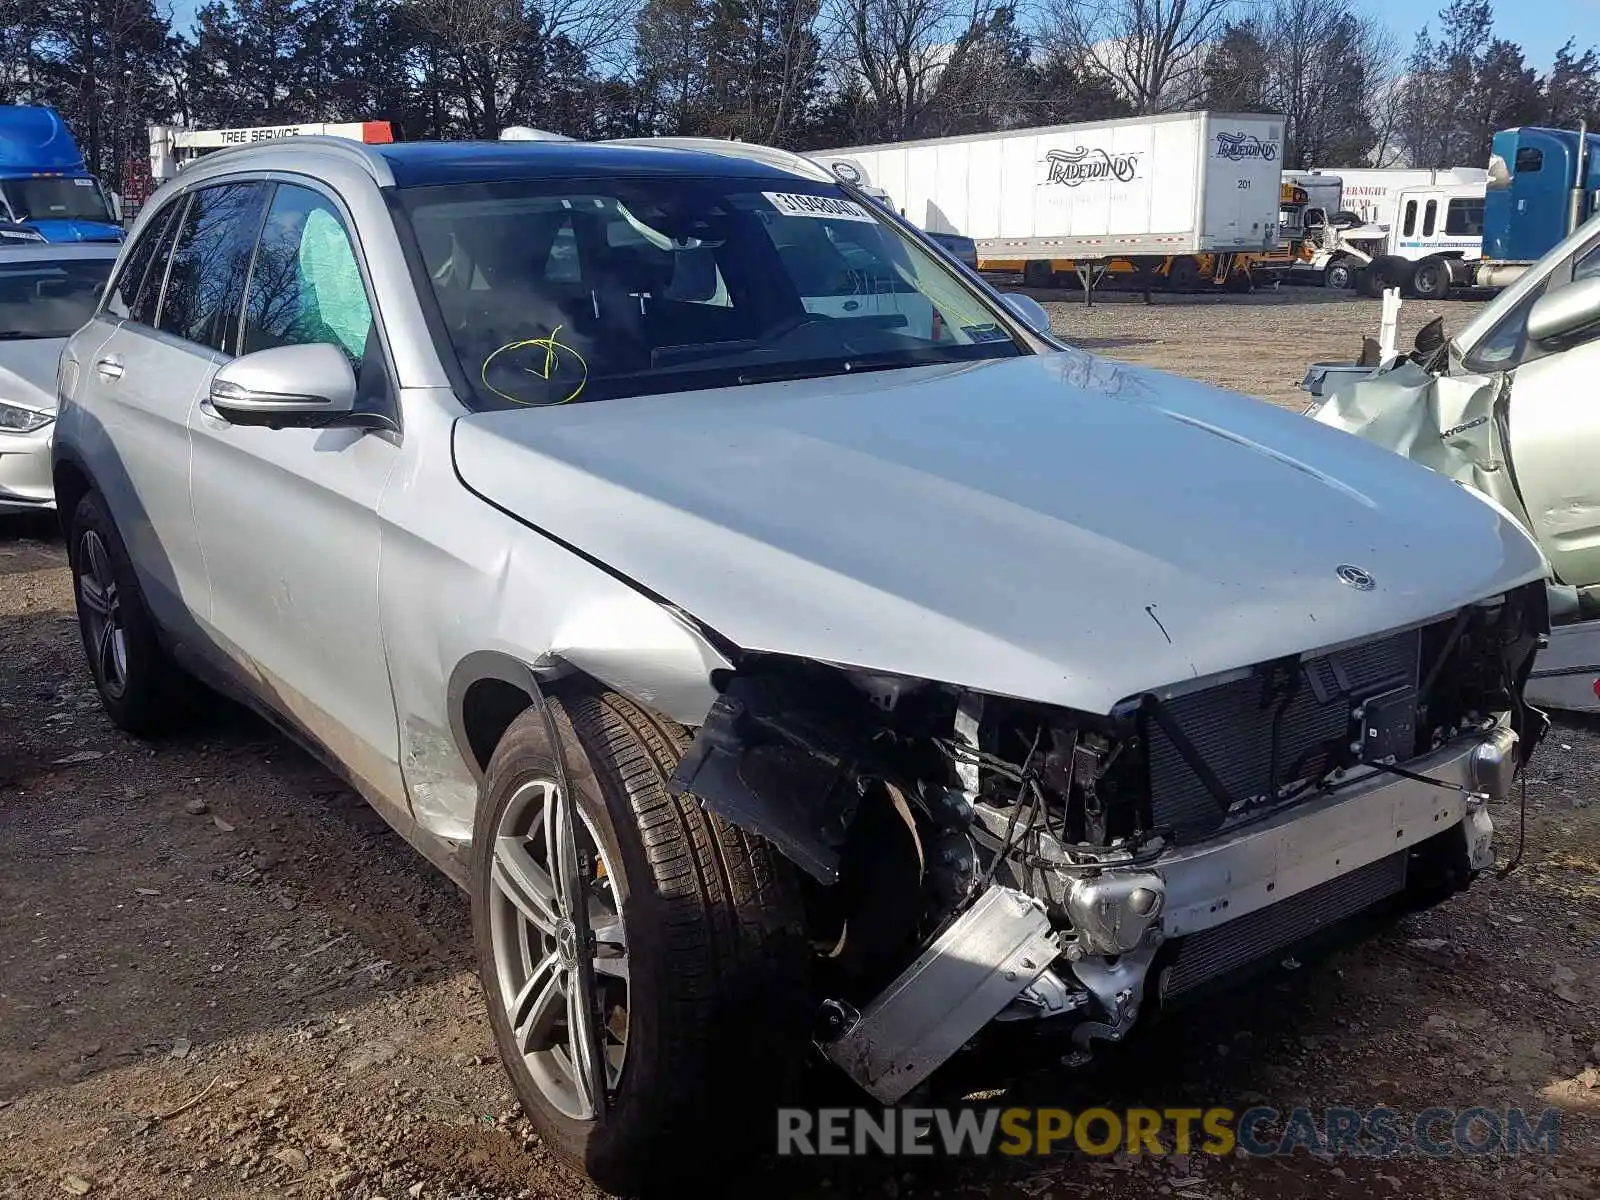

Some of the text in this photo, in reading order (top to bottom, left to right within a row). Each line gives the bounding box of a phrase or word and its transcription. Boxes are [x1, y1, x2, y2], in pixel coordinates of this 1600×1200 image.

[221, 128, 299, 143] TREE SERVICE
[1216, 132, 1277, 161] TRADEWINDS
[1046, 146, 1138, 187] TRADEWINDS
[1237, 179, 1252, 189] 201
